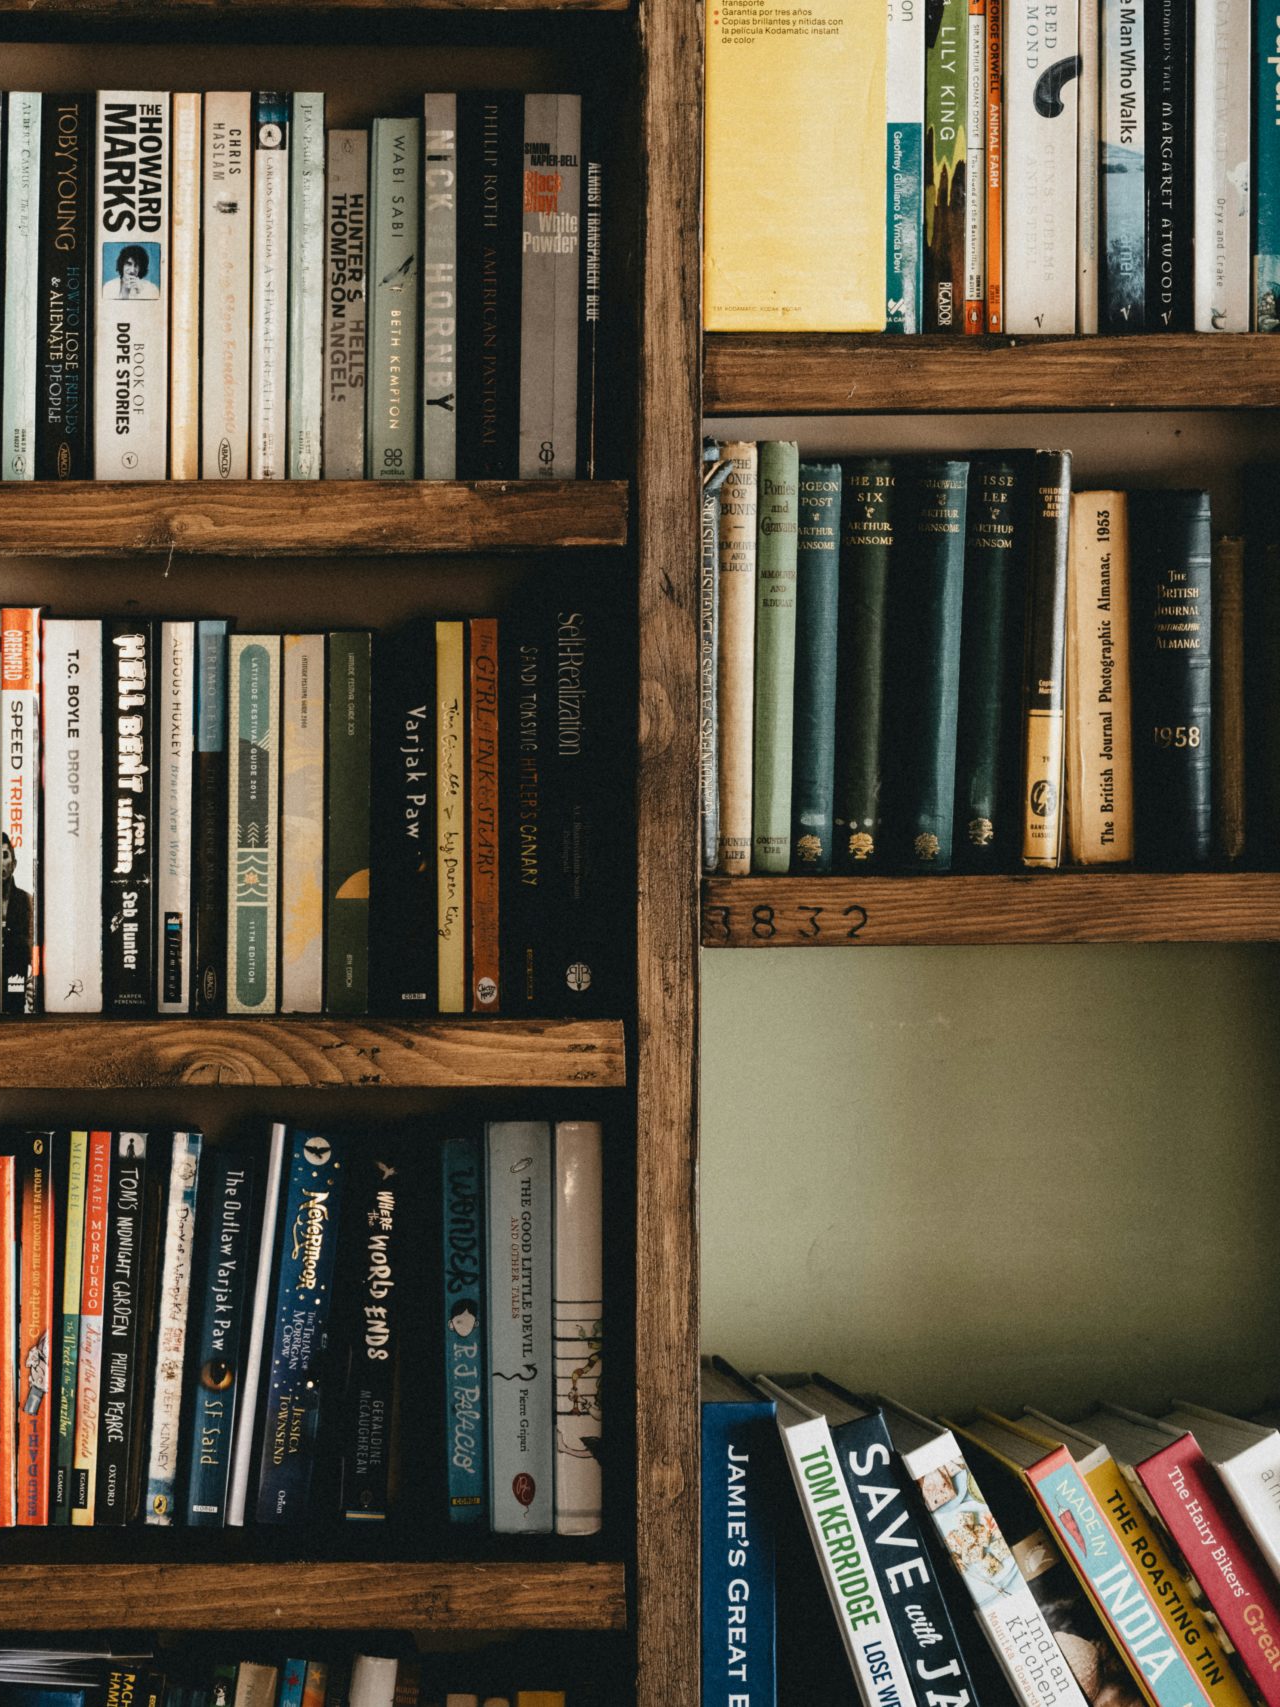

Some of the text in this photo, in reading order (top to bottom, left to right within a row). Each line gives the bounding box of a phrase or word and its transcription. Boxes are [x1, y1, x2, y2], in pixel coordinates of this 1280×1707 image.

[759, 9, 773, 17] por
[775, 8, 790, 16] tres
[792, 8, 812, 16] años
[1119, 9, 1136, 144] Man Who Walks
[141, 105, 162, 116] THE
[941, 27, 956, 141] LILY KING
[990, 104, 999, 187] ANIMAL FARM
[104, 104, 135, 232] MARKS
[139, 118, 162, 232] HOWARD
[1161, 102, 1173, 303] MARGARET ATWOOD
[586, 163, 601, 321] ALMOST TRANSPARENT BLUE
[939, 282, 952, 325] PICADOR
[116, 323, 130, 435] DOPE STORIES
[133, 343, 145, 415] BOOK OF
[67, 650, 79, 837] T.C. BOYLE DROP CITY
[1096, 510, 1114, 845] The British Journal Photographic Almanac, 1953
[10, 701, 23, 848] SPEED TRIBES
[400, 705, 427, 839] Varjak Paw
[120, 892, 138, 969] Seb Hunter
[111, 1168, 139, 1335] TOM'S MIDNIGHT GARDEN
[212, 1171, 244, 1350] The Outlaw Varjak Paw
[521, 1178, 533, 1357] THE GOOD LITTLE DEVIL
[105, 1353, 128, 1442] PHILIPPA PEARCE
[201, 1401, 224, 1464] SF Said
[107, 1465, 117, 1506] OXFORD
[800, 1446, 879, 1631] TOM KERRIDGE
[849, 1443, 943, 1648] SAVE with
[1166, 1466, 1252, 1599] The Hairy Bikers'
[727, 1445, 750, 1681] JAMIE'S GREAT
[1092, 1560, 1180, 1685] INDIA
[1107, 1490, 1224, 1687] THE ROASTING TIN
